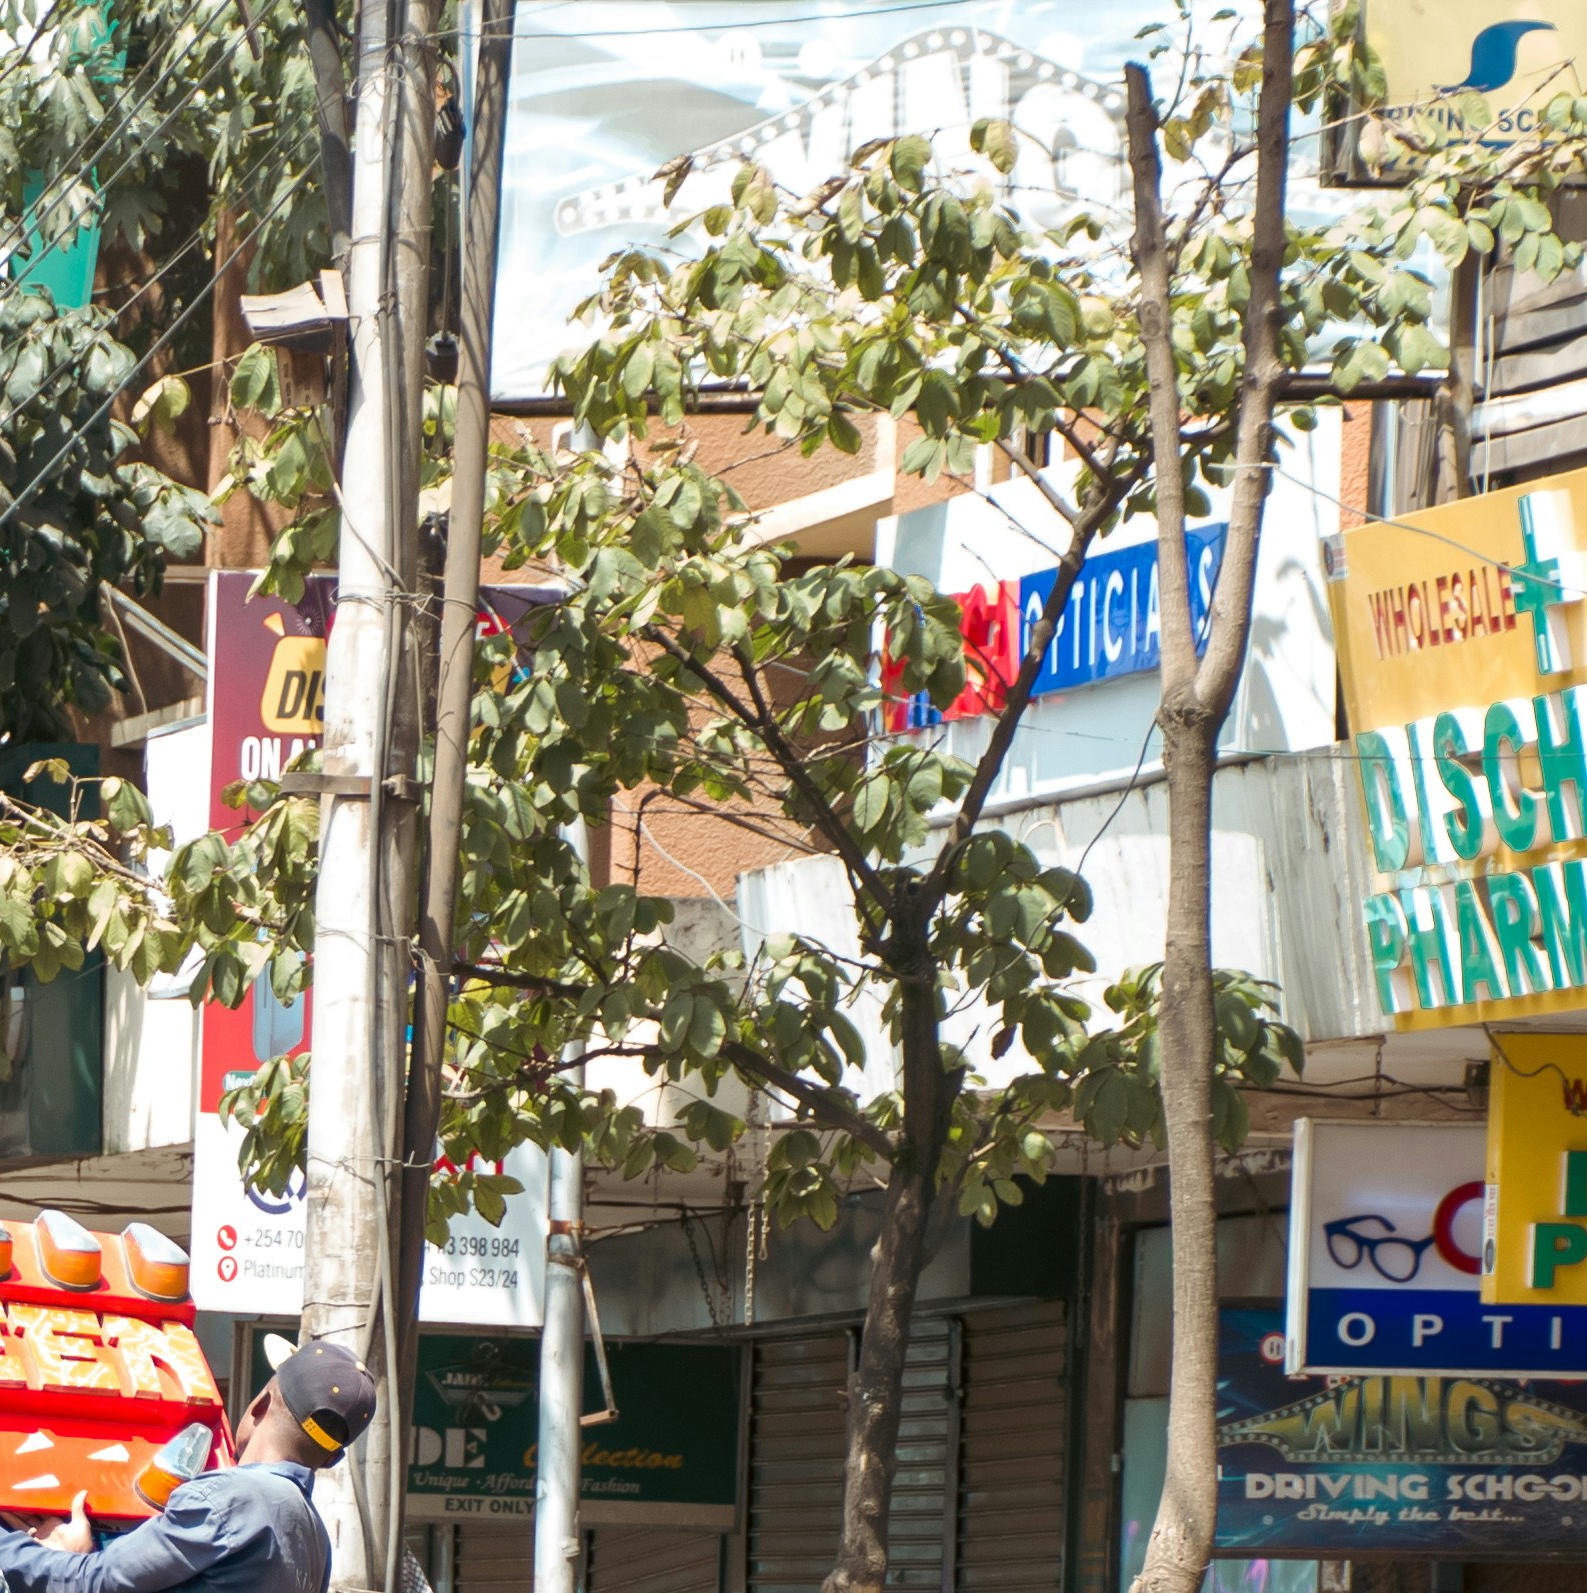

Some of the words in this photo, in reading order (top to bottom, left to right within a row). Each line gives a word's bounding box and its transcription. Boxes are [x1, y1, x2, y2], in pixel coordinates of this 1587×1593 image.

[1368, 562, 1516, 661] WHOLESALE
[459, 1237, 487, 1256] 398
[491, 1238, 520, 1257] 984
[430, 1266, 466, 1287] Shop
[413, 1471, 470, 1493] Unique
[1245, 1474, 1429, 1500] DRIVING
[444, 1497, 485, 1512] EXIT
[489, 1499, 534, 1514] ONLY
[1296, 1503, 1391, 1526] Simply
[1398, 1505, 1442, 1522] the
